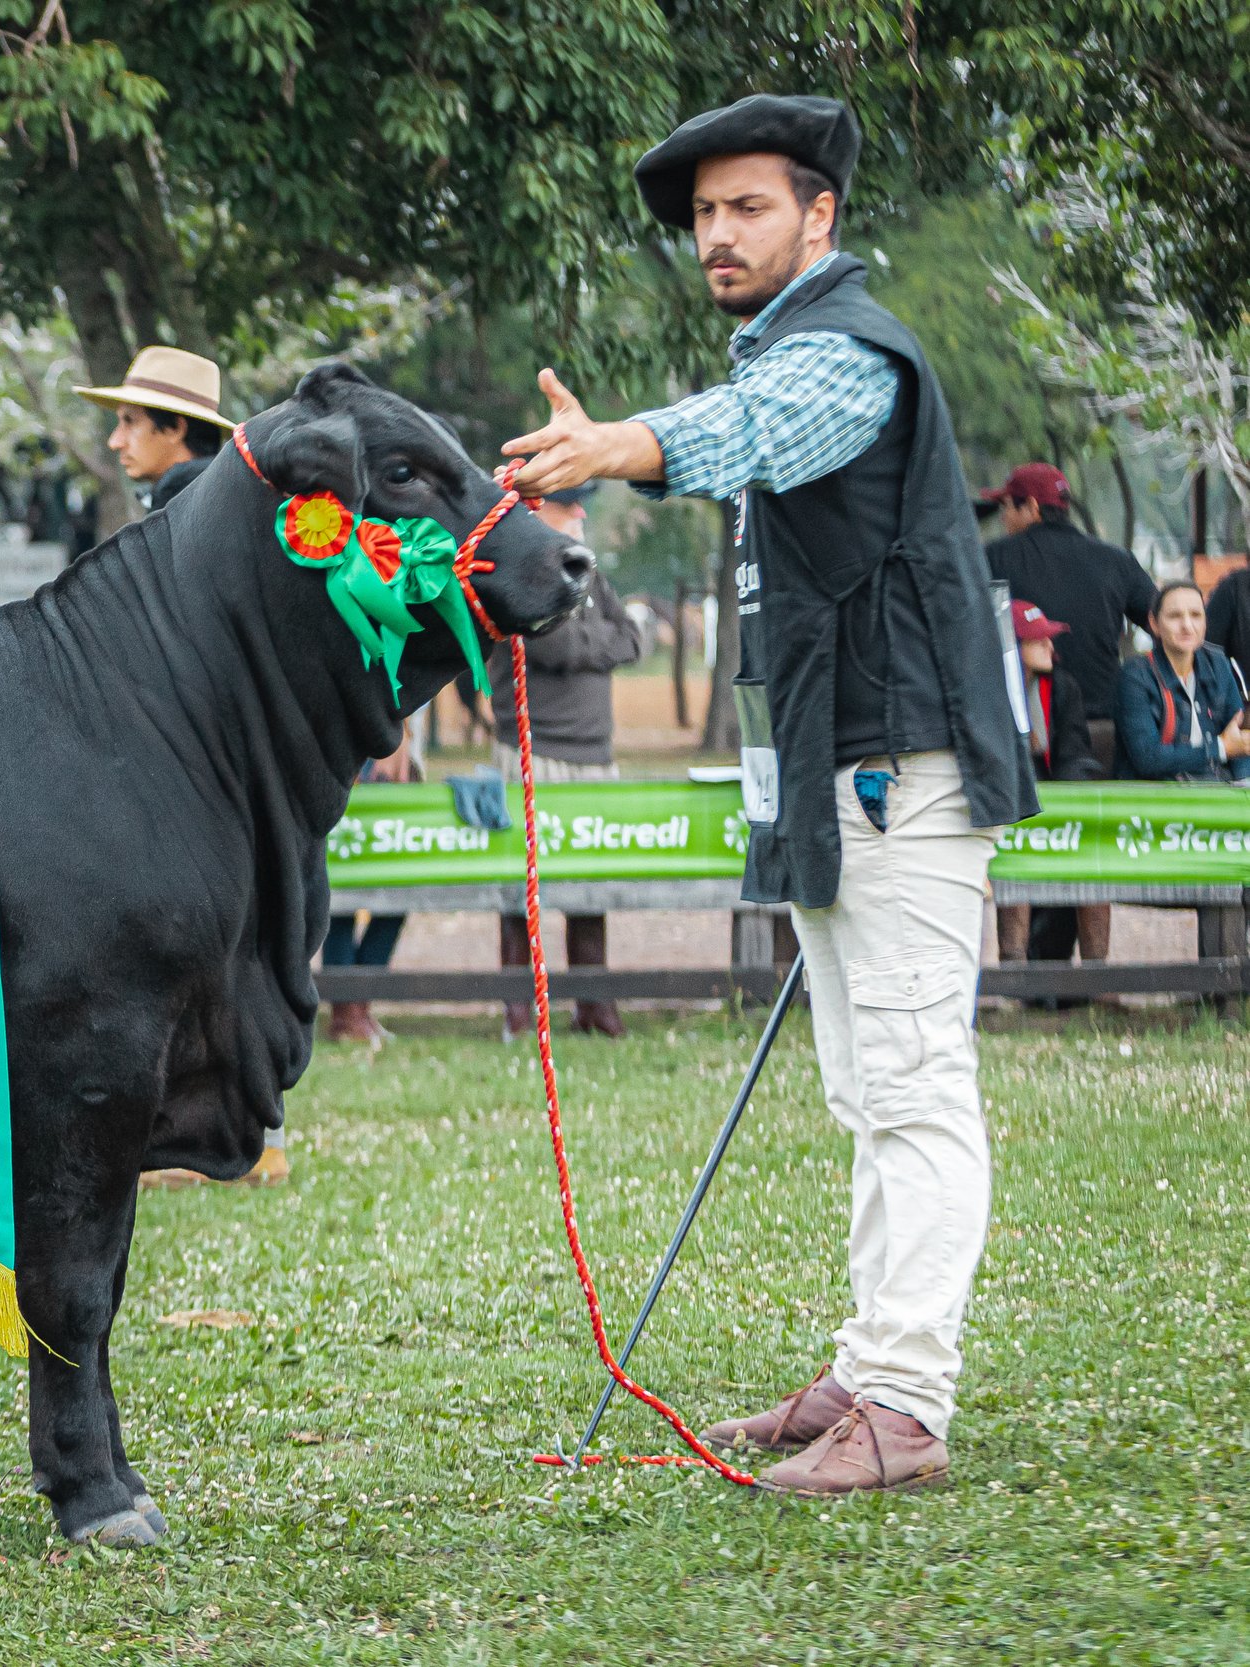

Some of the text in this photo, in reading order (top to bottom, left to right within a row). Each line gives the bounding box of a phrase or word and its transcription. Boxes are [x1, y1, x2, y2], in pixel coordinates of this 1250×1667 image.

[570, 815, 689, 848] Sicredi
[997, 821, 1082, 850] credi
[1160, 823, 1250, 852] Sicre
